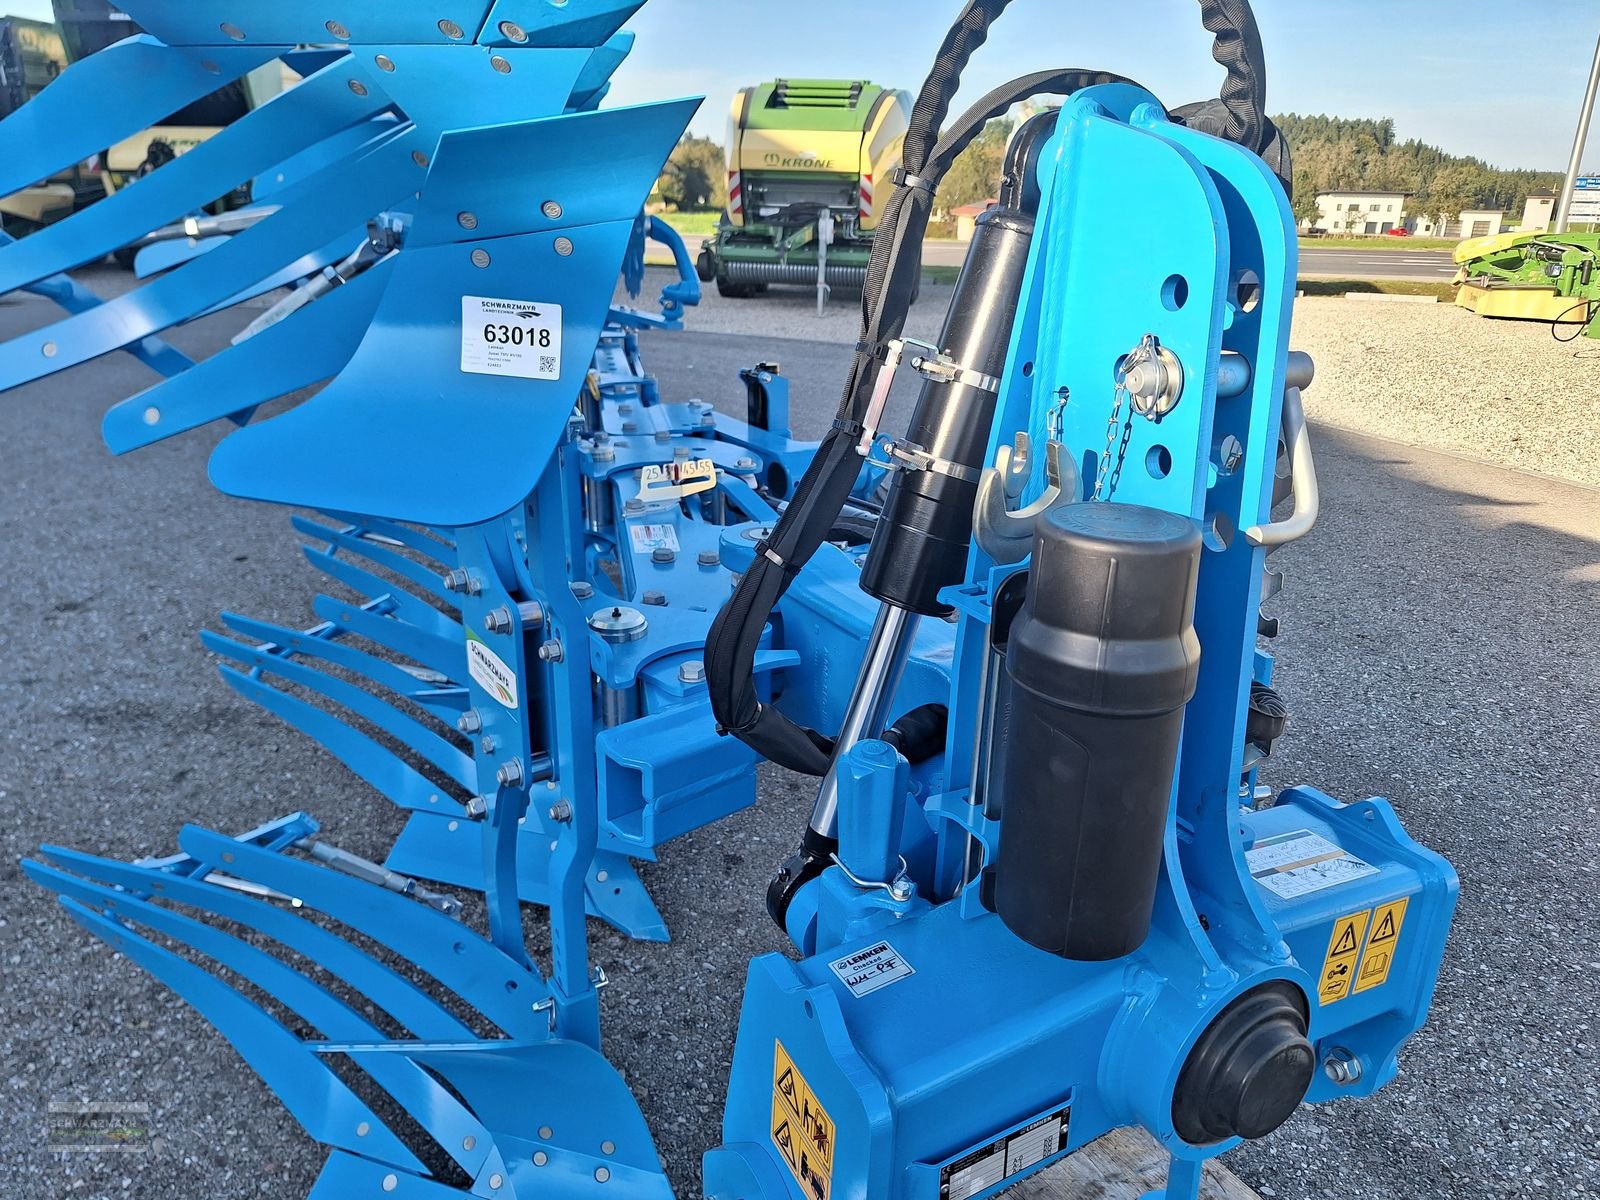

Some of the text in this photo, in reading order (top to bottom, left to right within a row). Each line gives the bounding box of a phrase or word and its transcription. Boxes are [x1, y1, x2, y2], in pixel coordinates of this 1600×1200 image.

[782, 158, 834, 169] KRONE
[481, 301, 537, 311] SCHWARZMAYR
[484, 324, 551, 348] 63018
[646, 467, 659, 480] 25
[699, 460, 711, 473] 55
[471, 641, 510, 688] SCHWARZMAYR
[846, 944, 888, 966] LEMKEN
[852, 956, 882, 971] Checked
[1026, 1115, 1053, 1132] LEMKEN
